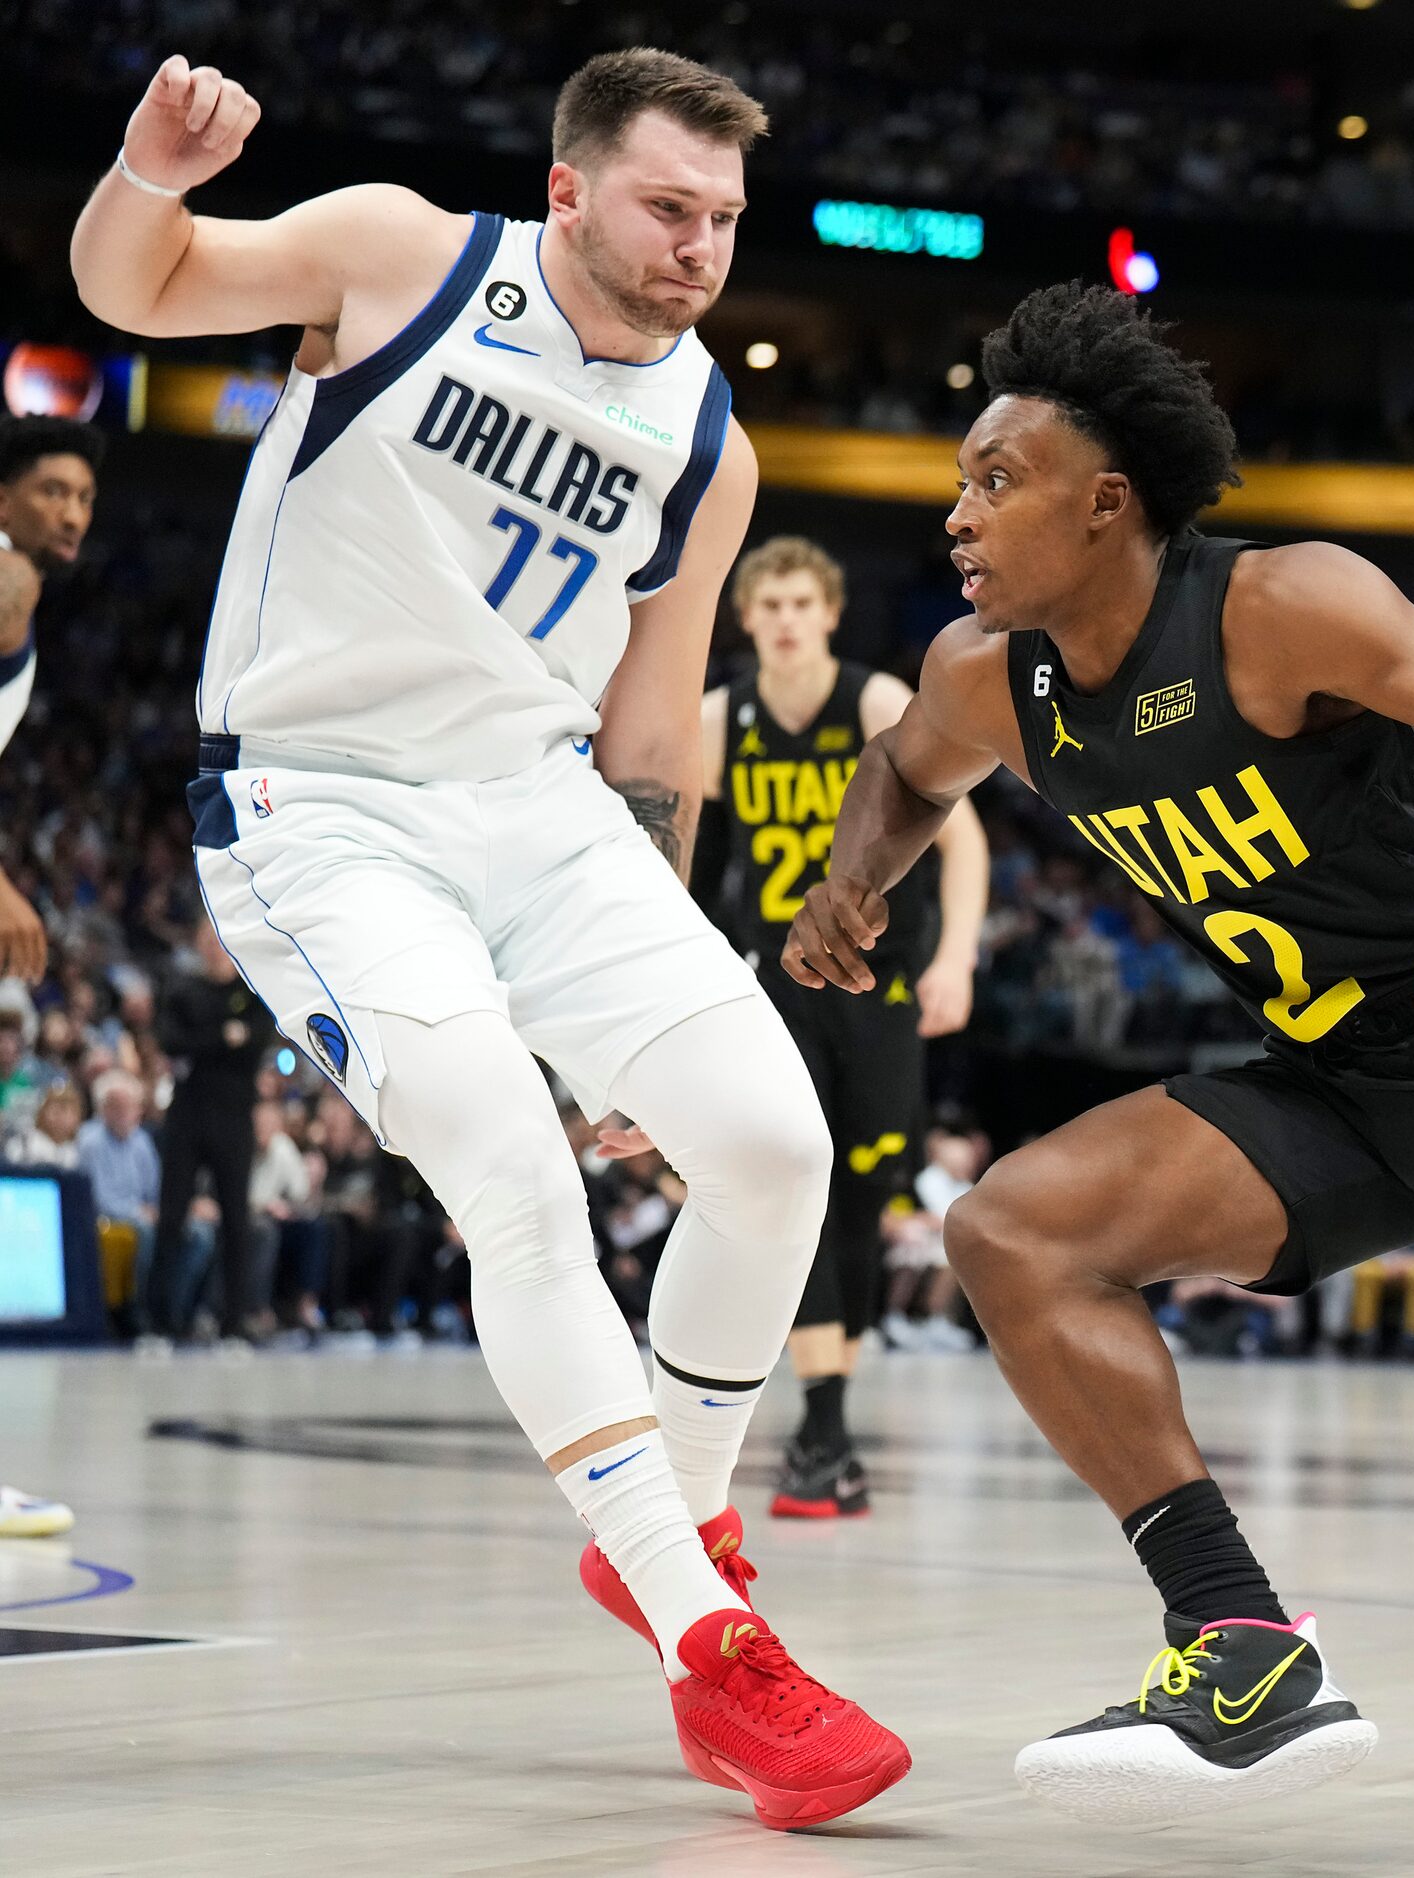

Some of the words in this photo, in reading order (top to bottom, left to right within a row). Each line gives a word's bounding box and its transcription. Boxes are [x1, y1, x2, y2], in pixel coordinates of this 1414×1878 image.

[491, 286, 520, 317] 6
[605, 402, 674, 447] chime
[409, 373, 641, 537] DALLAS
[481, 503, 600, 642] 77
[1033, 664, 1053, 697] 6
[1162, 691, 1176, 702] FOR
[1177, 685, 1189, 698] THE
[1140, 697, 1155, 729] 5
[1159, 698, 1193, 723] FIGHT
[1067, 764, 1310, 905] UTAH
[1204, 910, 1366, 1043] 2
